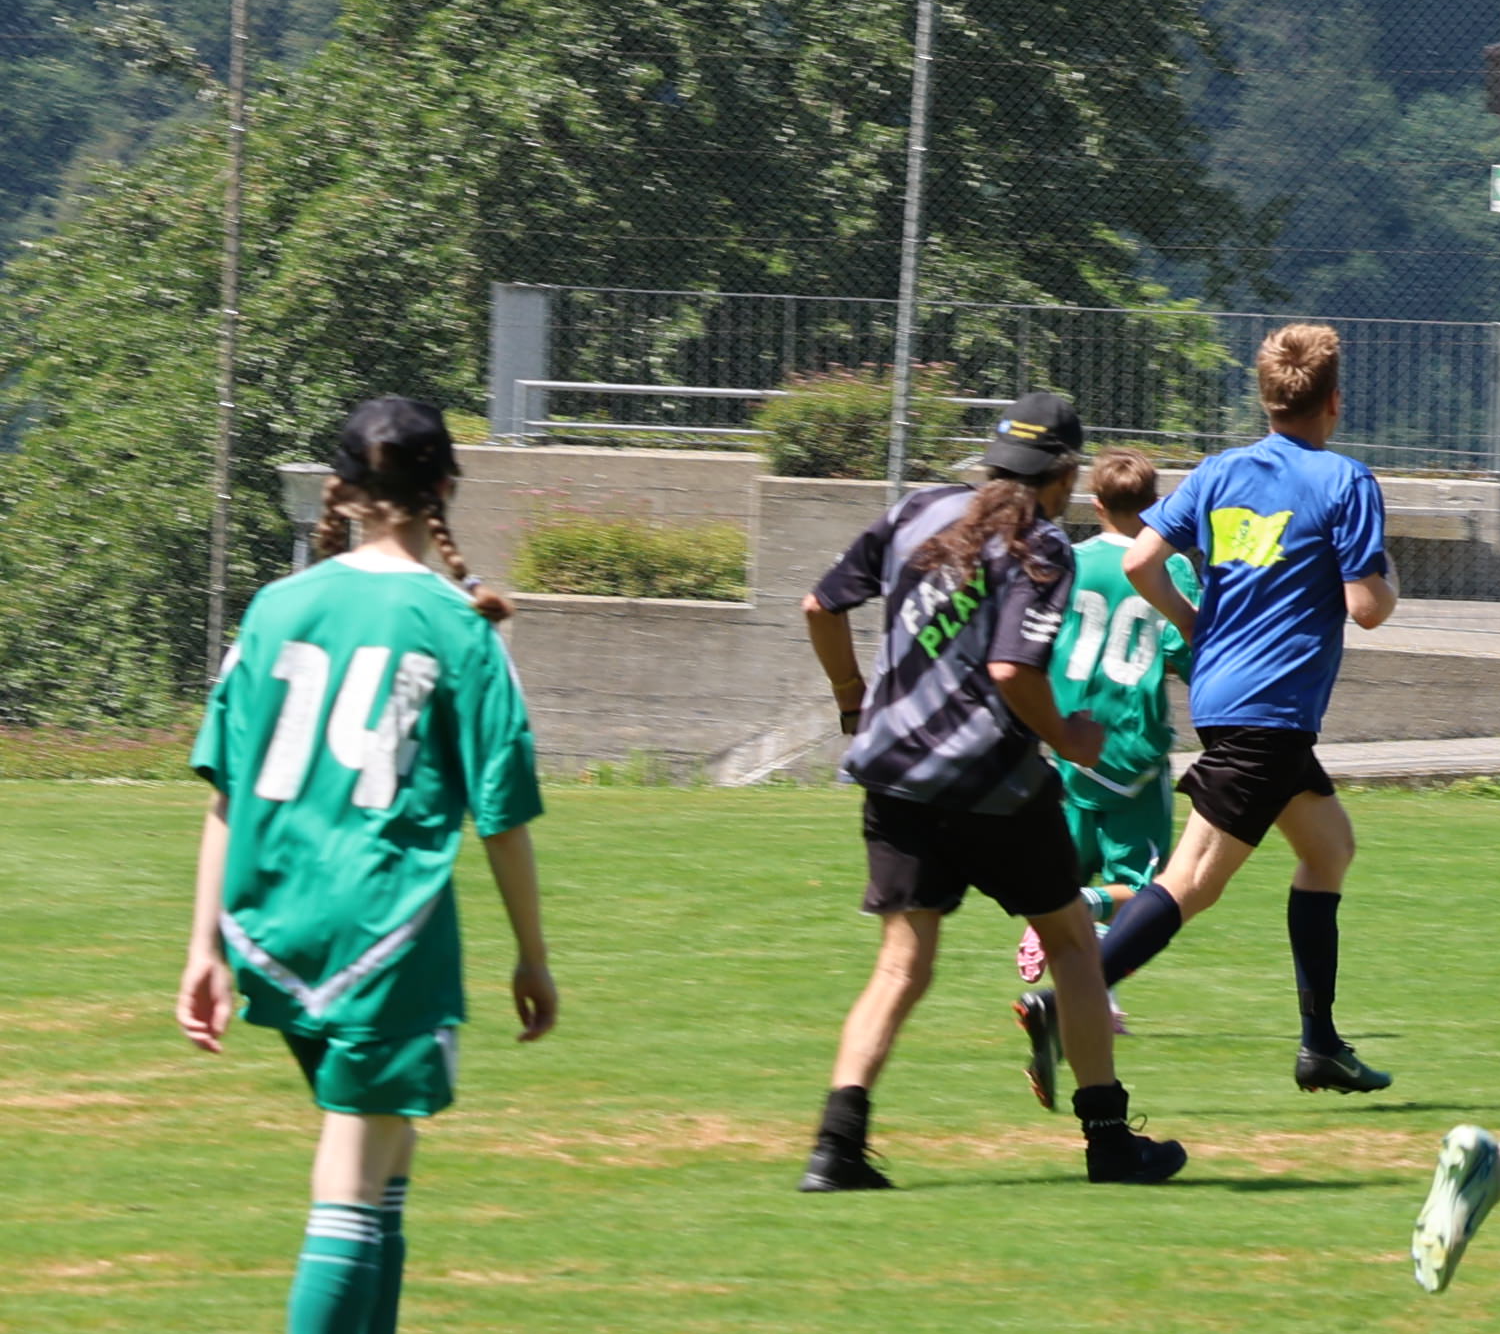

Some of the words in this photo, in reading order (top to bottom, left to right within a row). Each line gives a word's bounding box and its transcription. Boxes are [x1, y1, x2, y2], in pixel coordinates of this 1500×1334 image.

[917, 568, 986, 659] PLAY
[1065, 589, 1158, 686] 10
[253, 640, 440, 810] 14
